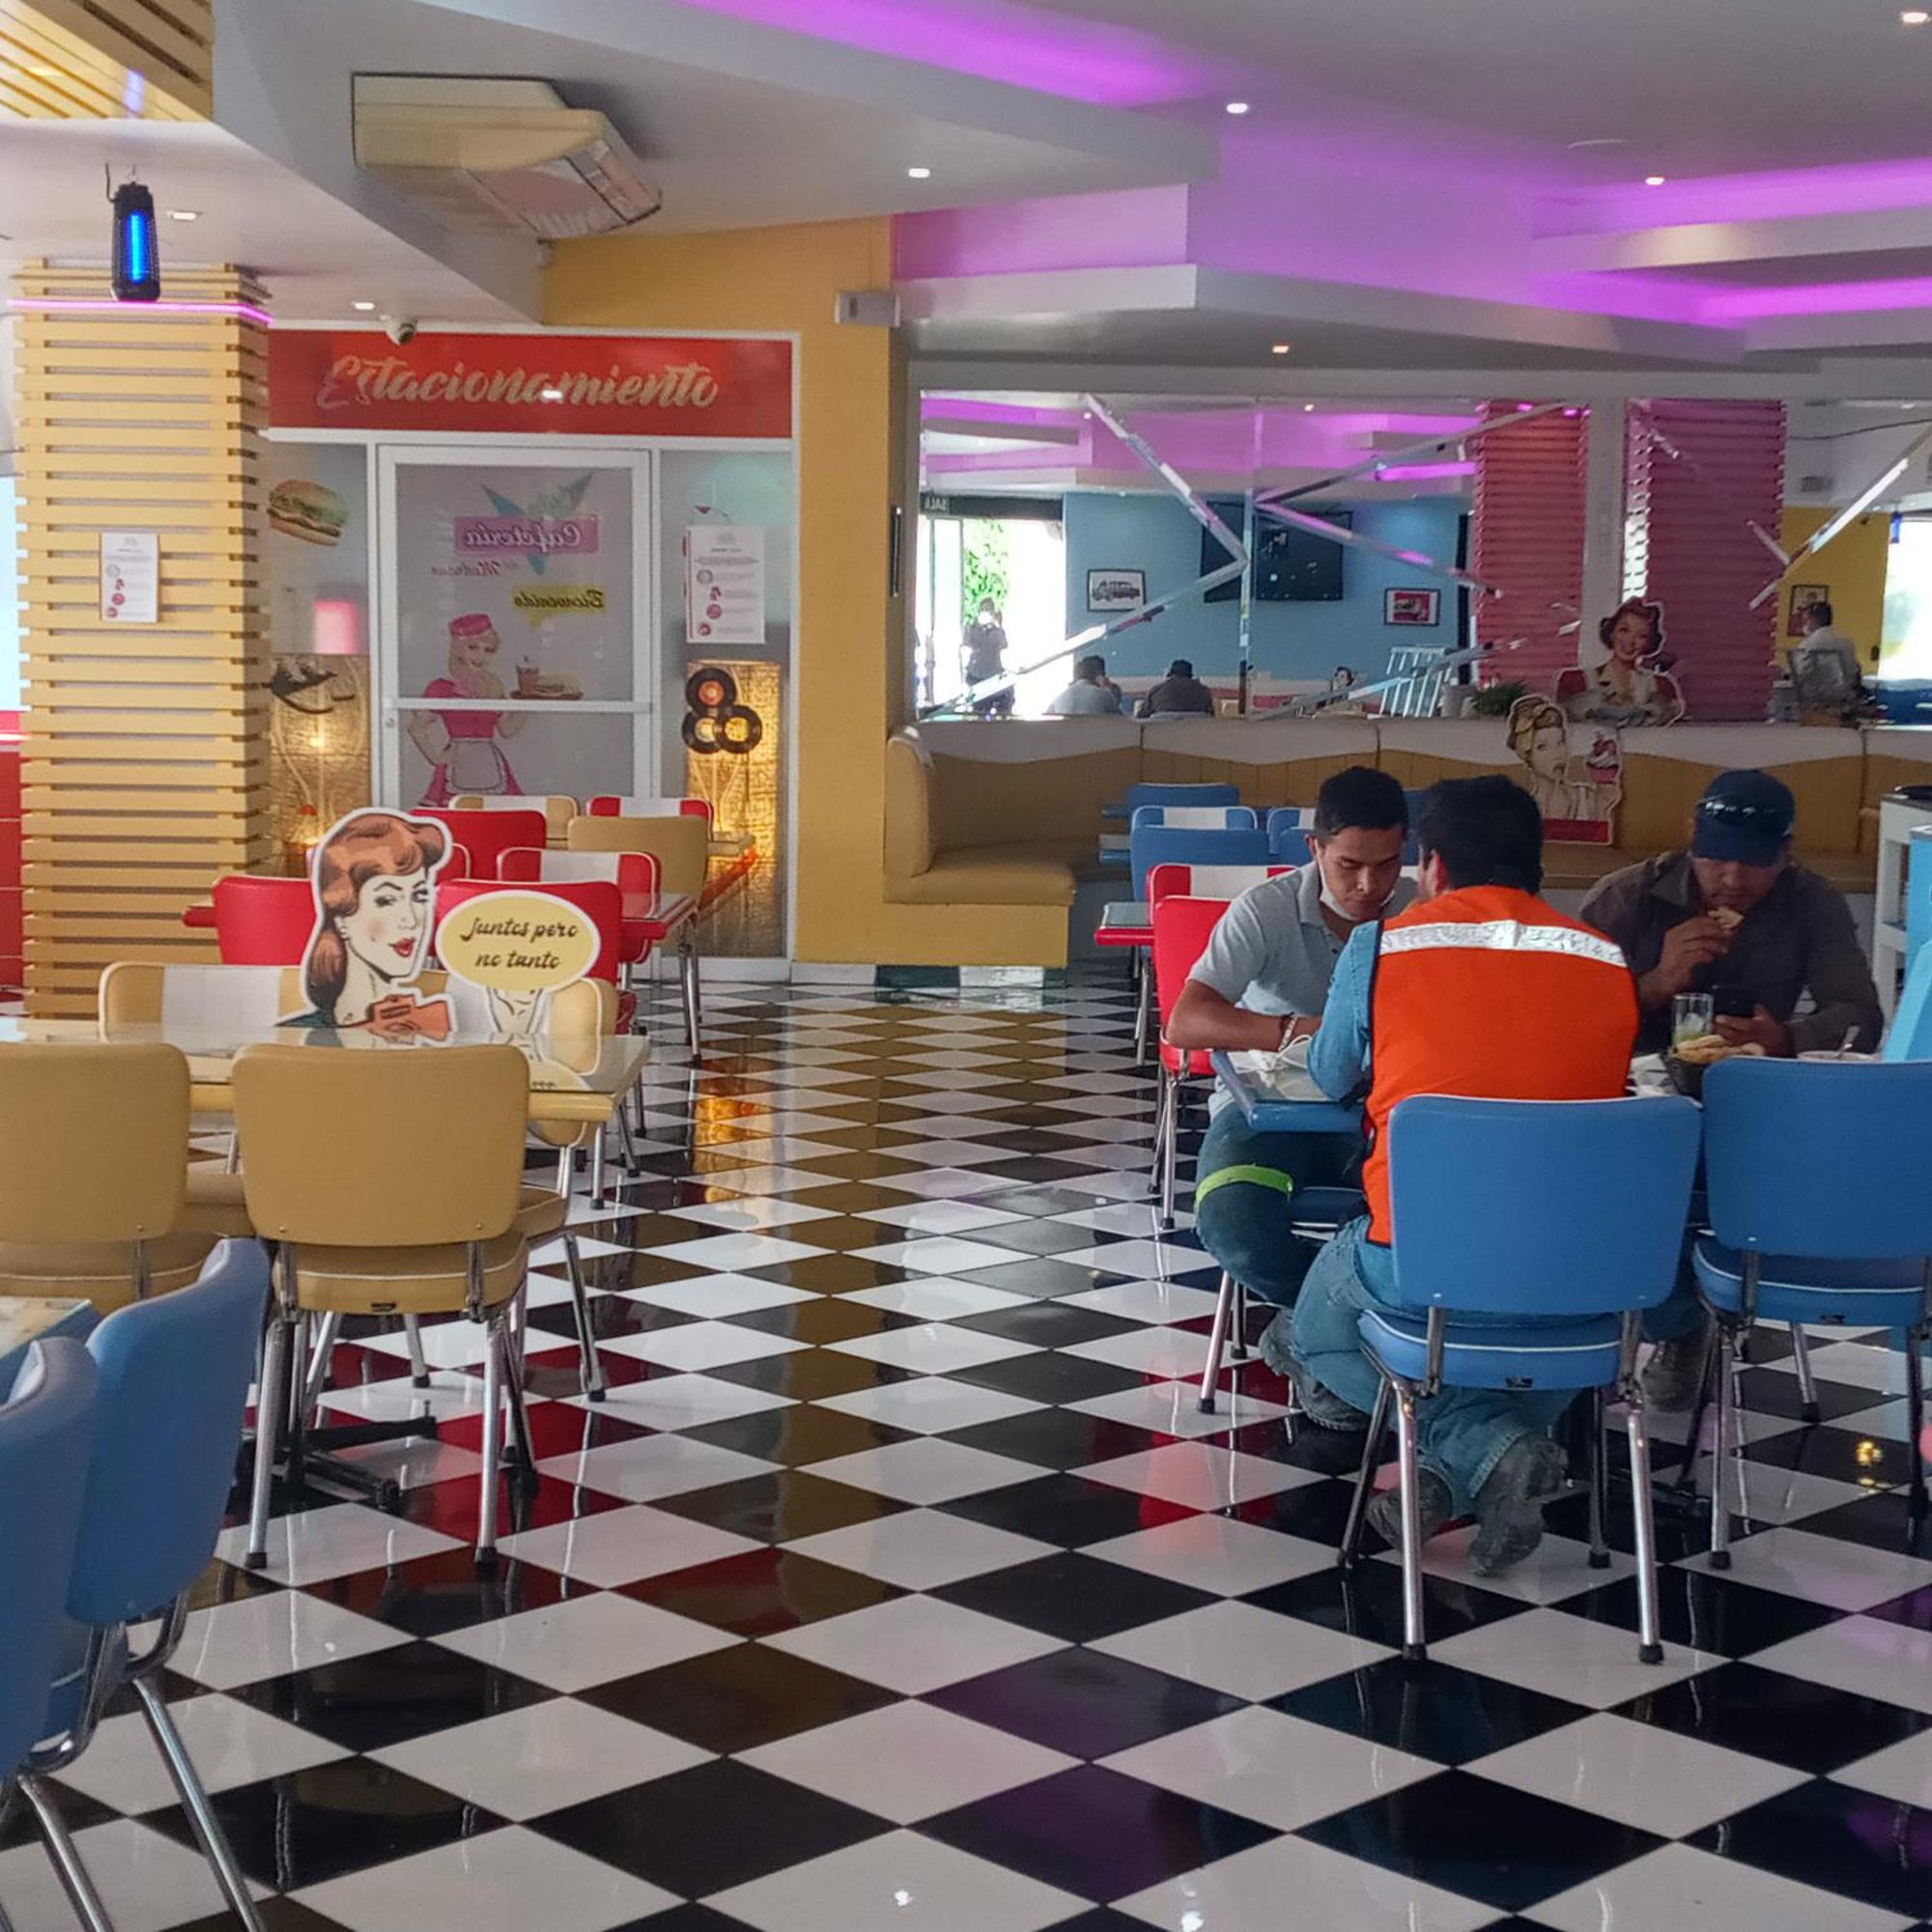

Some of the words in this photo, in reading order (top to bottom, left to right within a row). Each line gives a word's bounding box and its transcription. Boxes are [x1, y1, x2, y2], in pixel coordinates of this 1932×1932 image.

[316, 355, 718, 409] Estacionamiento
[529, 922, 578, 943] pero
[475, 952, 501, 967] no
[507, 951, 559, 969] tanto
